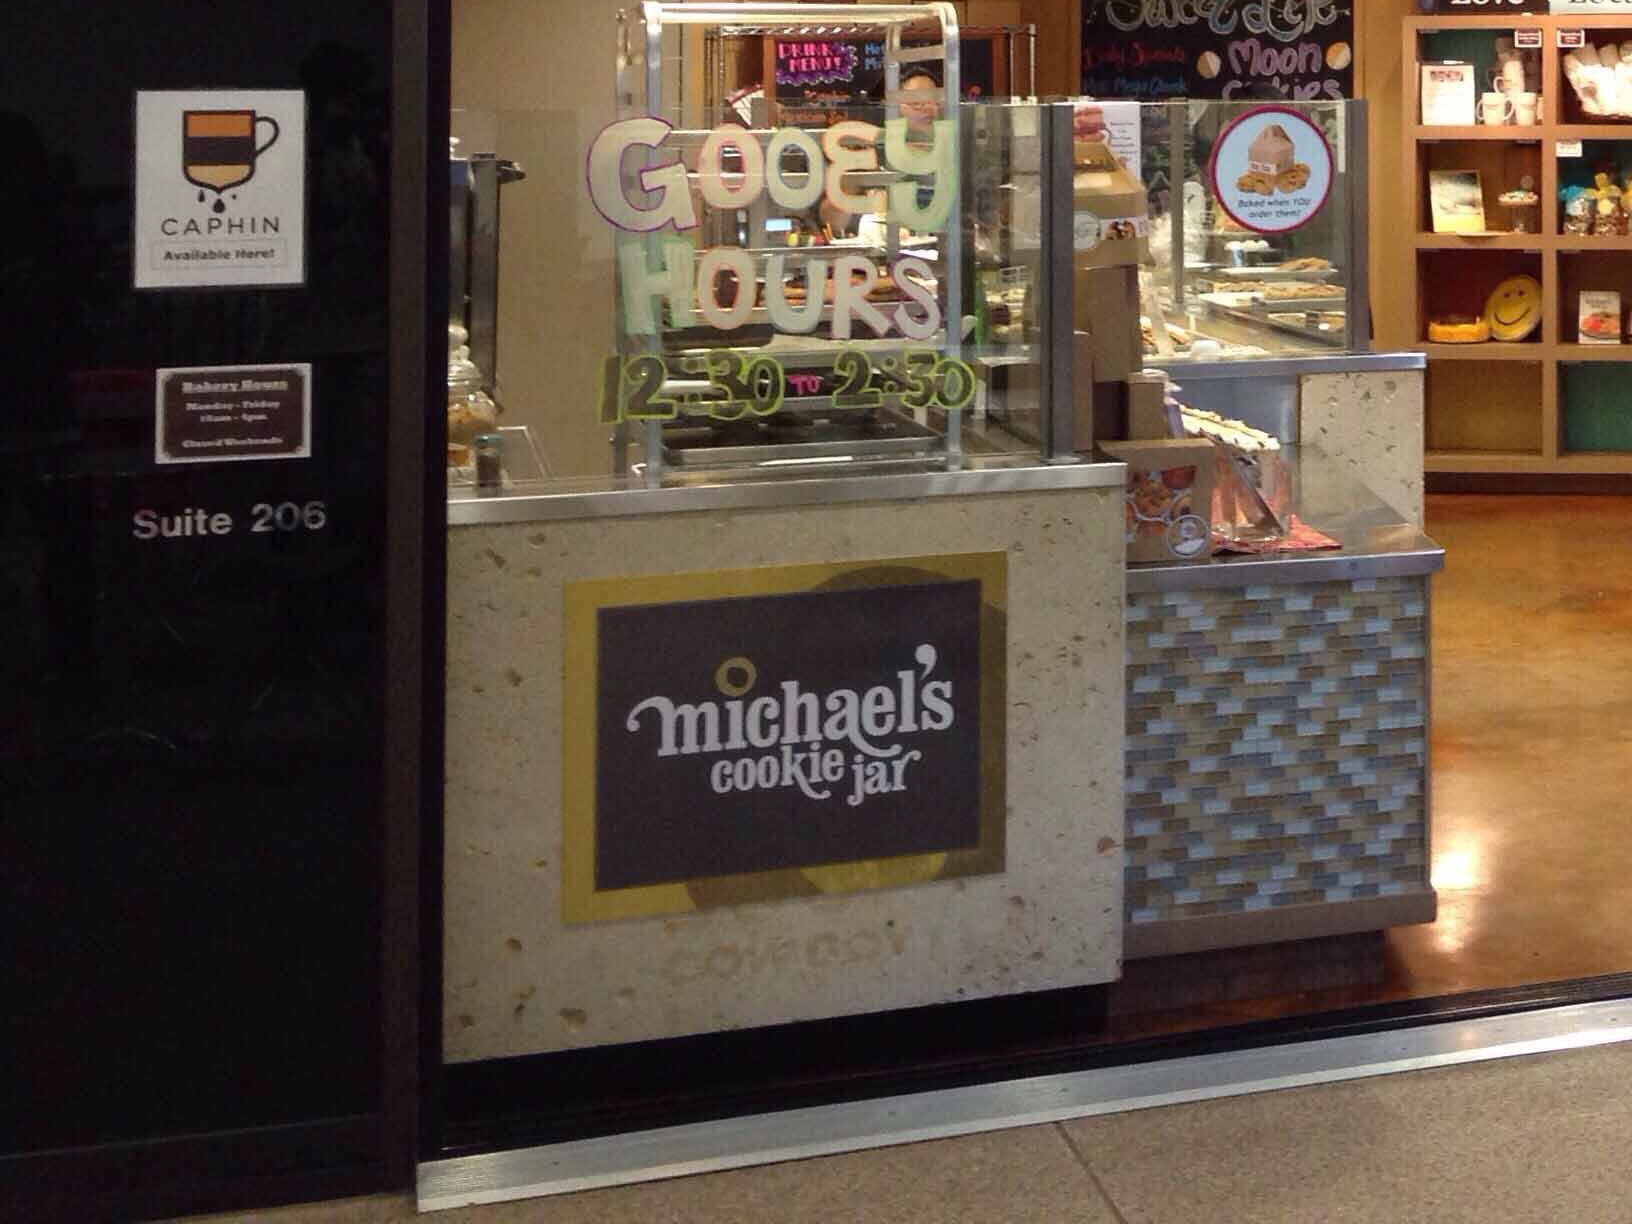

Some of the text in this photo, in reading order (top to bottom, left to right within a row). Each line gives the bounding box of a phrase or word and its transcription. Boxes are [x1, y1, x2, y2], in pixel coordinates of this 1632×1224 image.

[1228, 38, 1322, 77] Moon
[587, 116, 960, 232] GOOEY
[160, 217, 280, 236] CAPHIN
[164, 250, 231, 261] Available
[619, 238, 943, 340] HOURS
[600, 348, 785, 425] 12:30
[132, 501, 326, 539] Suite 206
[627, 643, 954, 757] michael's
[710, 742, 923, 807] cookie jar
